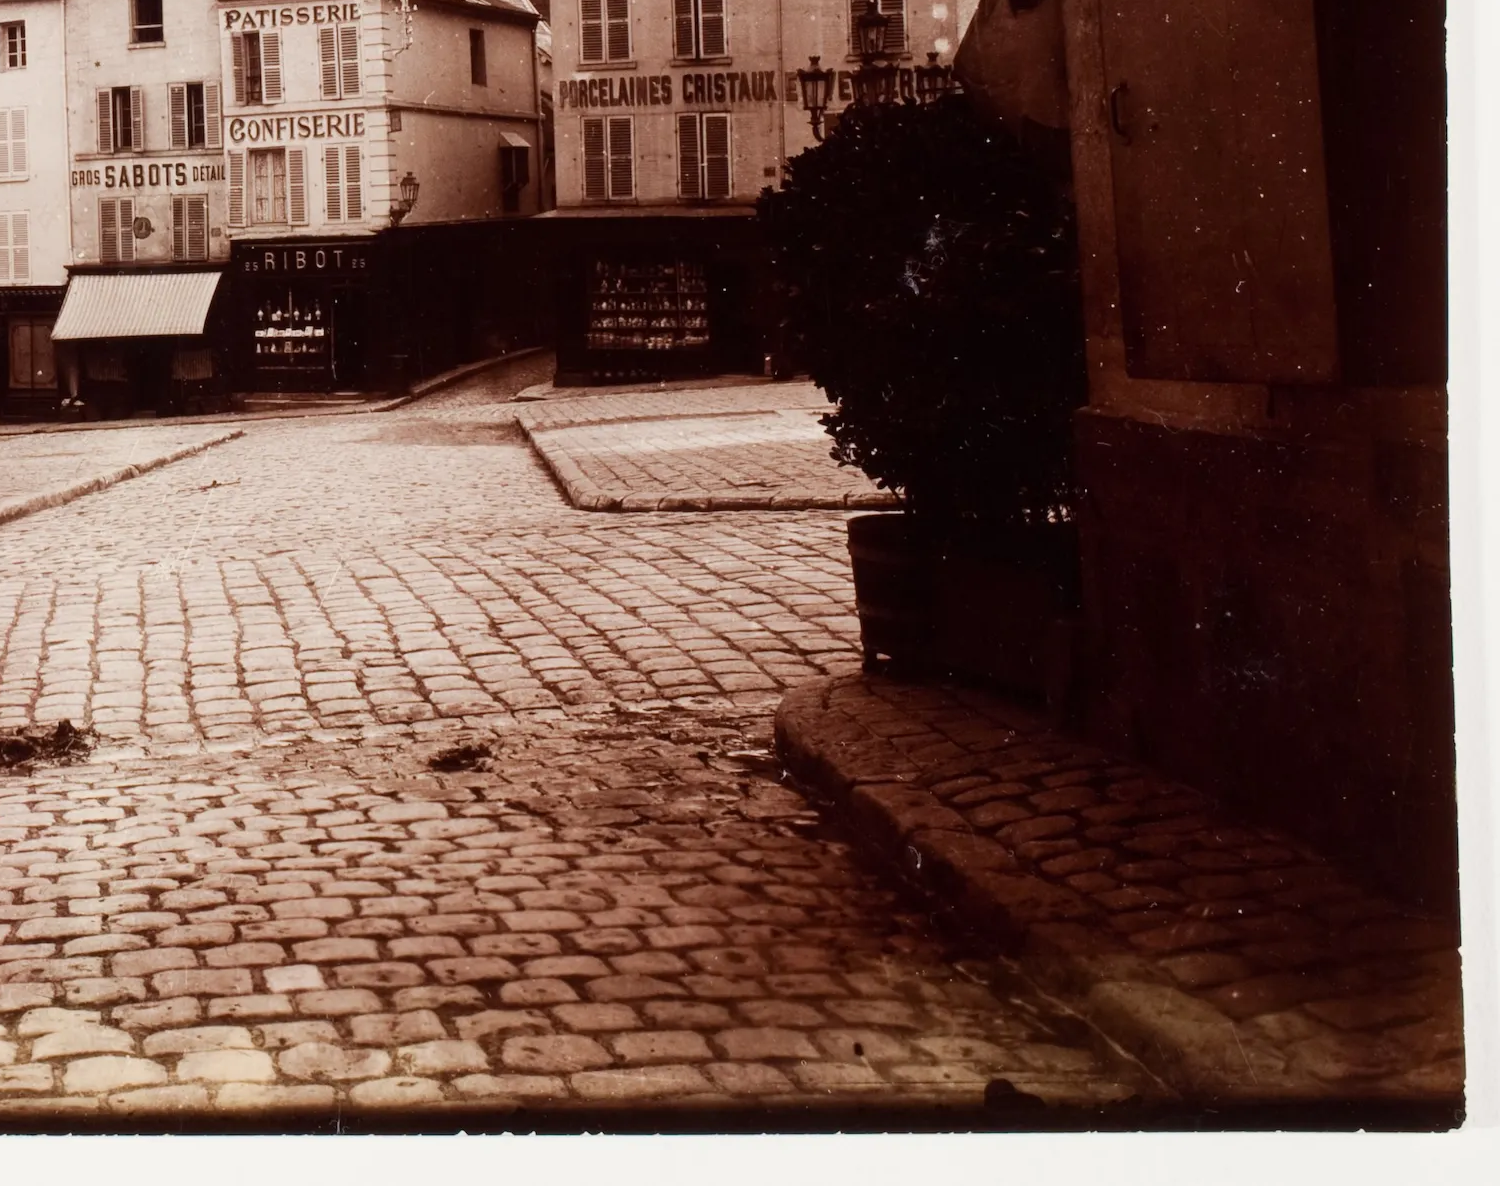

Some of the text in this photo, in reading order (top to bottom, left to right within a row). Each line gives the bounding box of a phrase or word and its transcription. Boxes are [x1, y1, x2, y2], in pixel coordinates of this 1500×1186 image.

[224, 3, 361, 30] PATISSERIE
[559, 75, 673, 108] PORCELAINES
[682, 71, 779, 104] CRISTAUX
[229, 112, 366, 143] CONFISERIE
[71, 170, 100, 186] GROS
[105, 163, 188, 188] SABOTS
[264, 250, 343, 270] RIBOT
